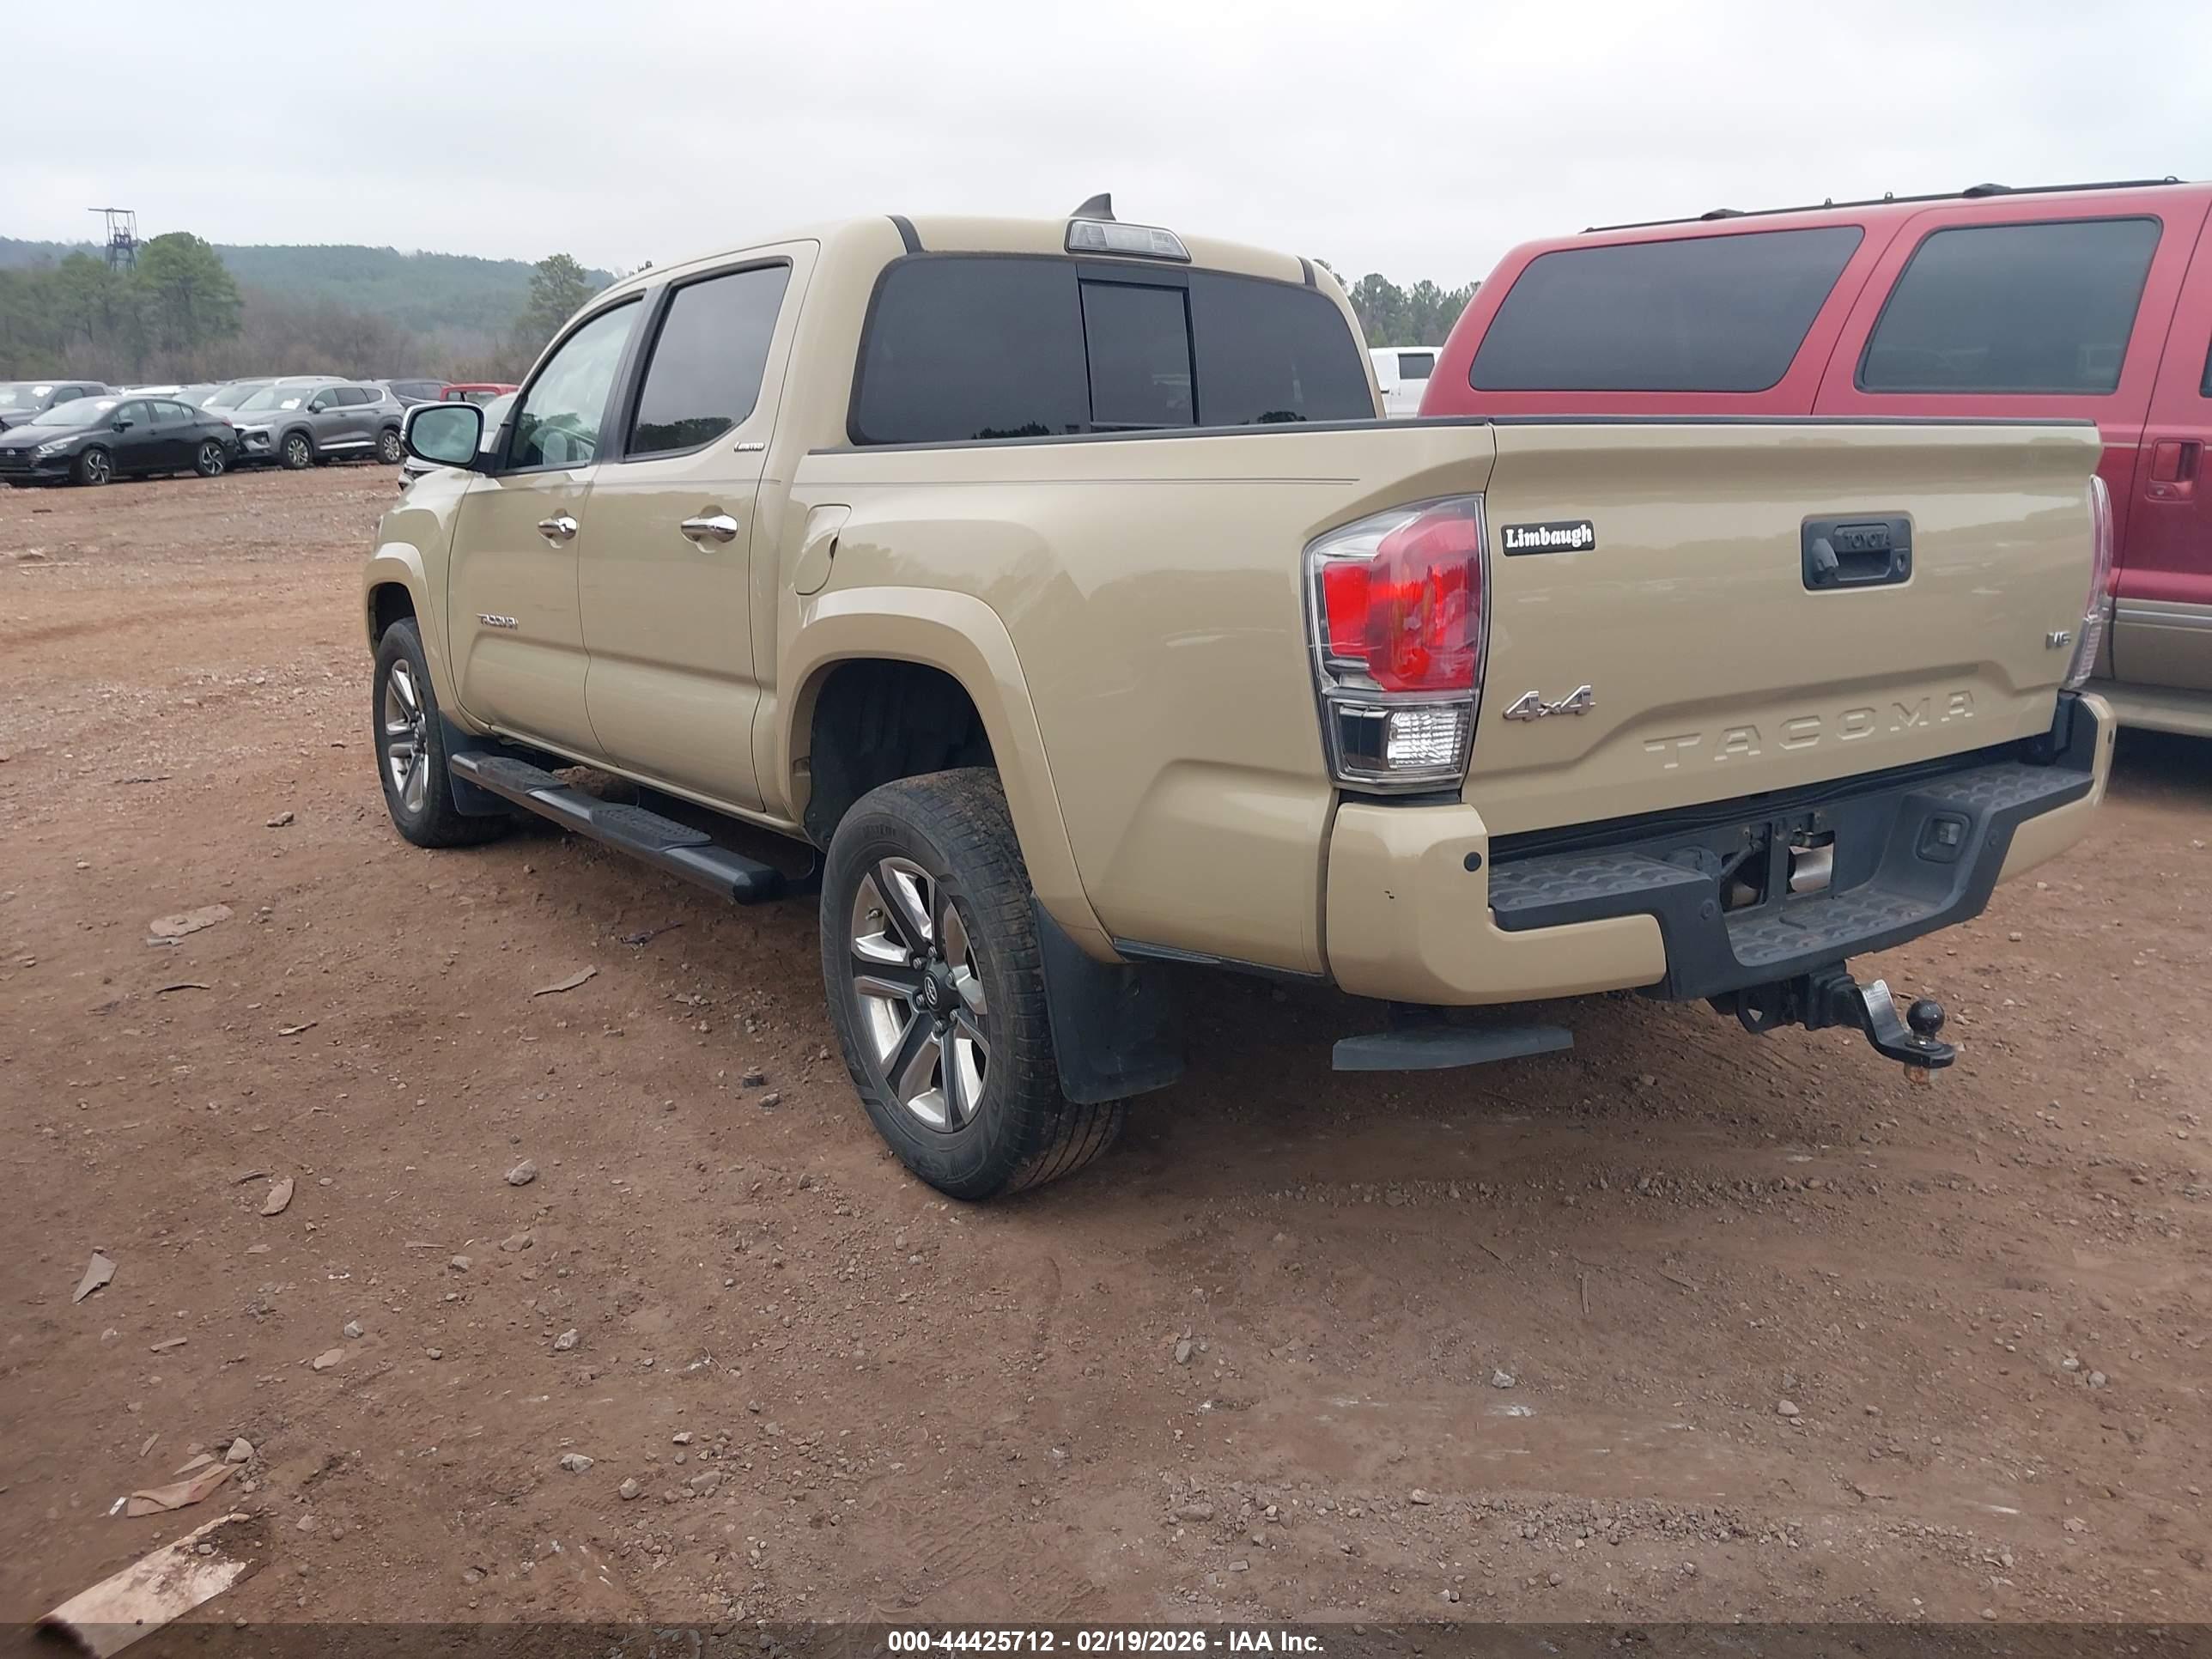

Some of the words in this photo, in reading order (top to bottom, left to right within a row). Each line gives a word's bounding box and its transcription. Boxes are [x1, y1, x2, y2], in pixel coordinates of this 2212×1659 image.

[1505, 524, 1593, 548] Limbaugh
[1843, 531, 1890, 549] TOYOTA
[1643, 690, 1975, 769] TACOMA
